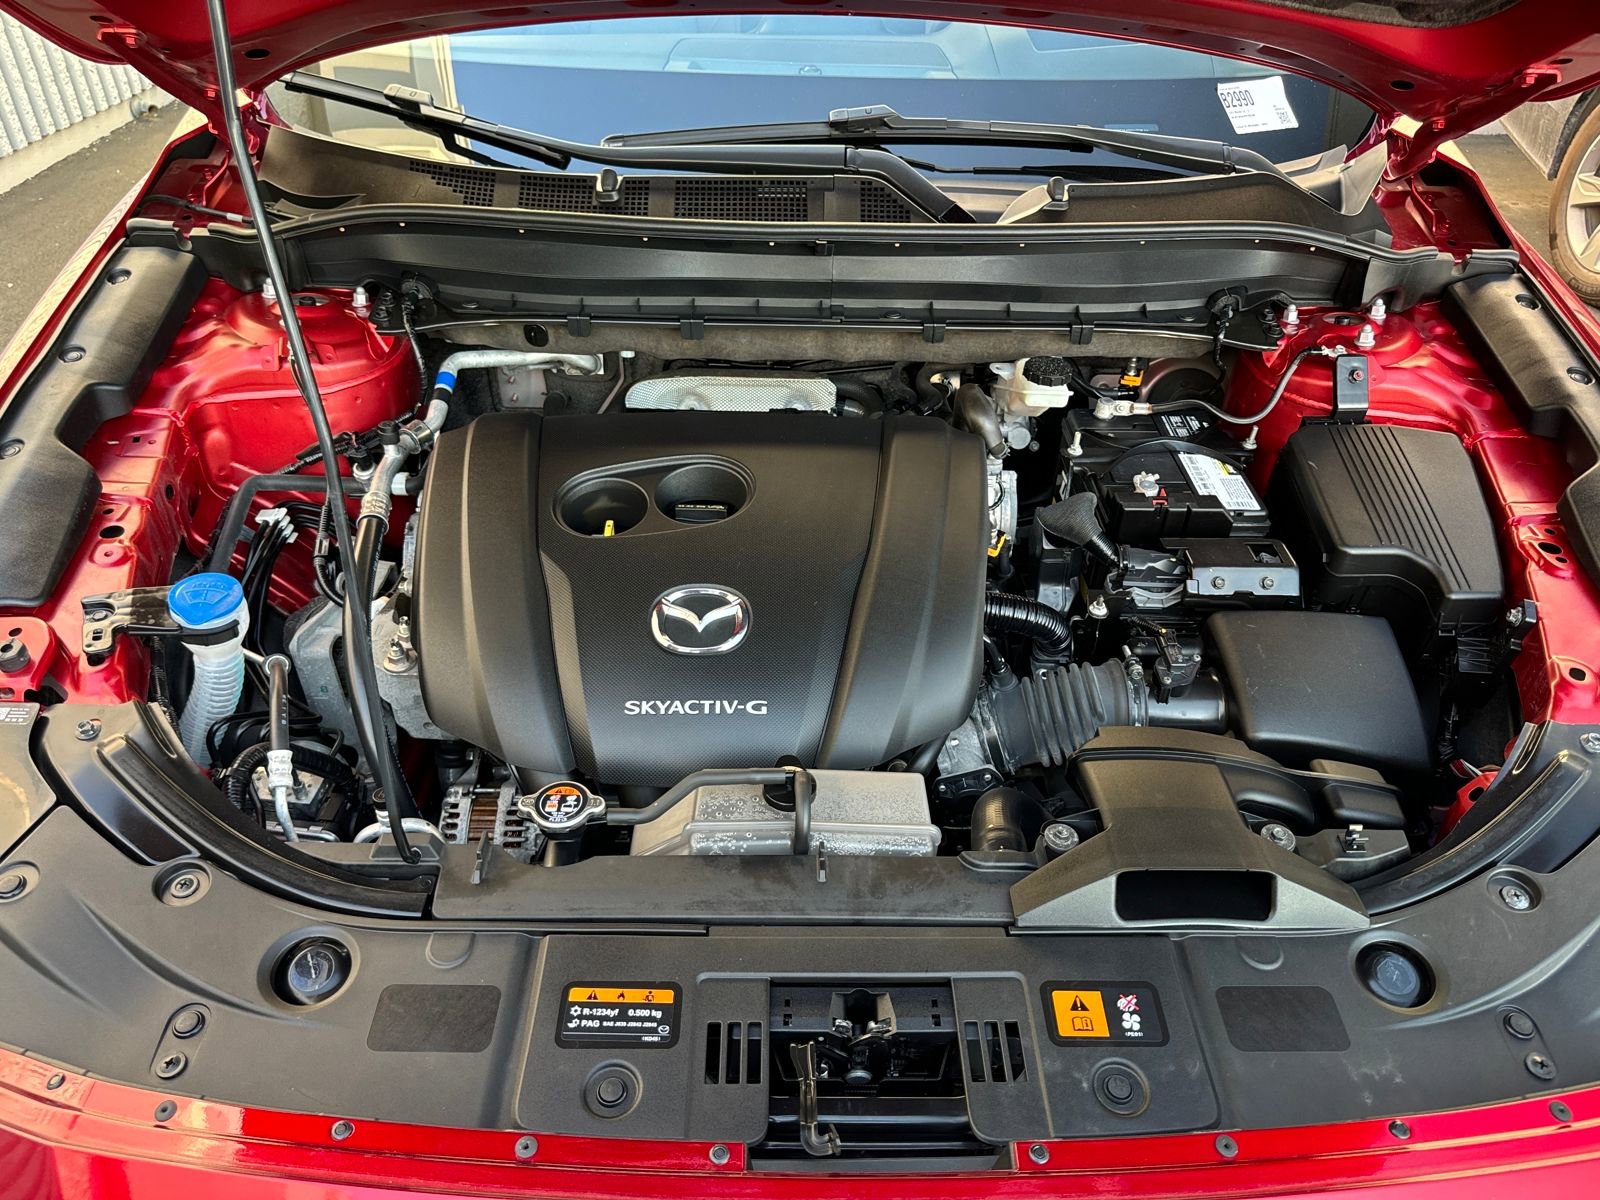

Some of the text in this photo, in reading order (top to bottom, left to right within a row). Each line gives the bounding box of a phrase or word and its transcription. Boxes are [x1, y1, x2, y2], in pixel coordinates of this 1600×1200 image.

[1219, 89, 1255, 108] B2990
[624, 699, 768, 715] SKYACTIV-G
[583, 1008, 662, 1018] R-1234yf 0.500 kg
[581, 1019, 600, 1028] PAG
